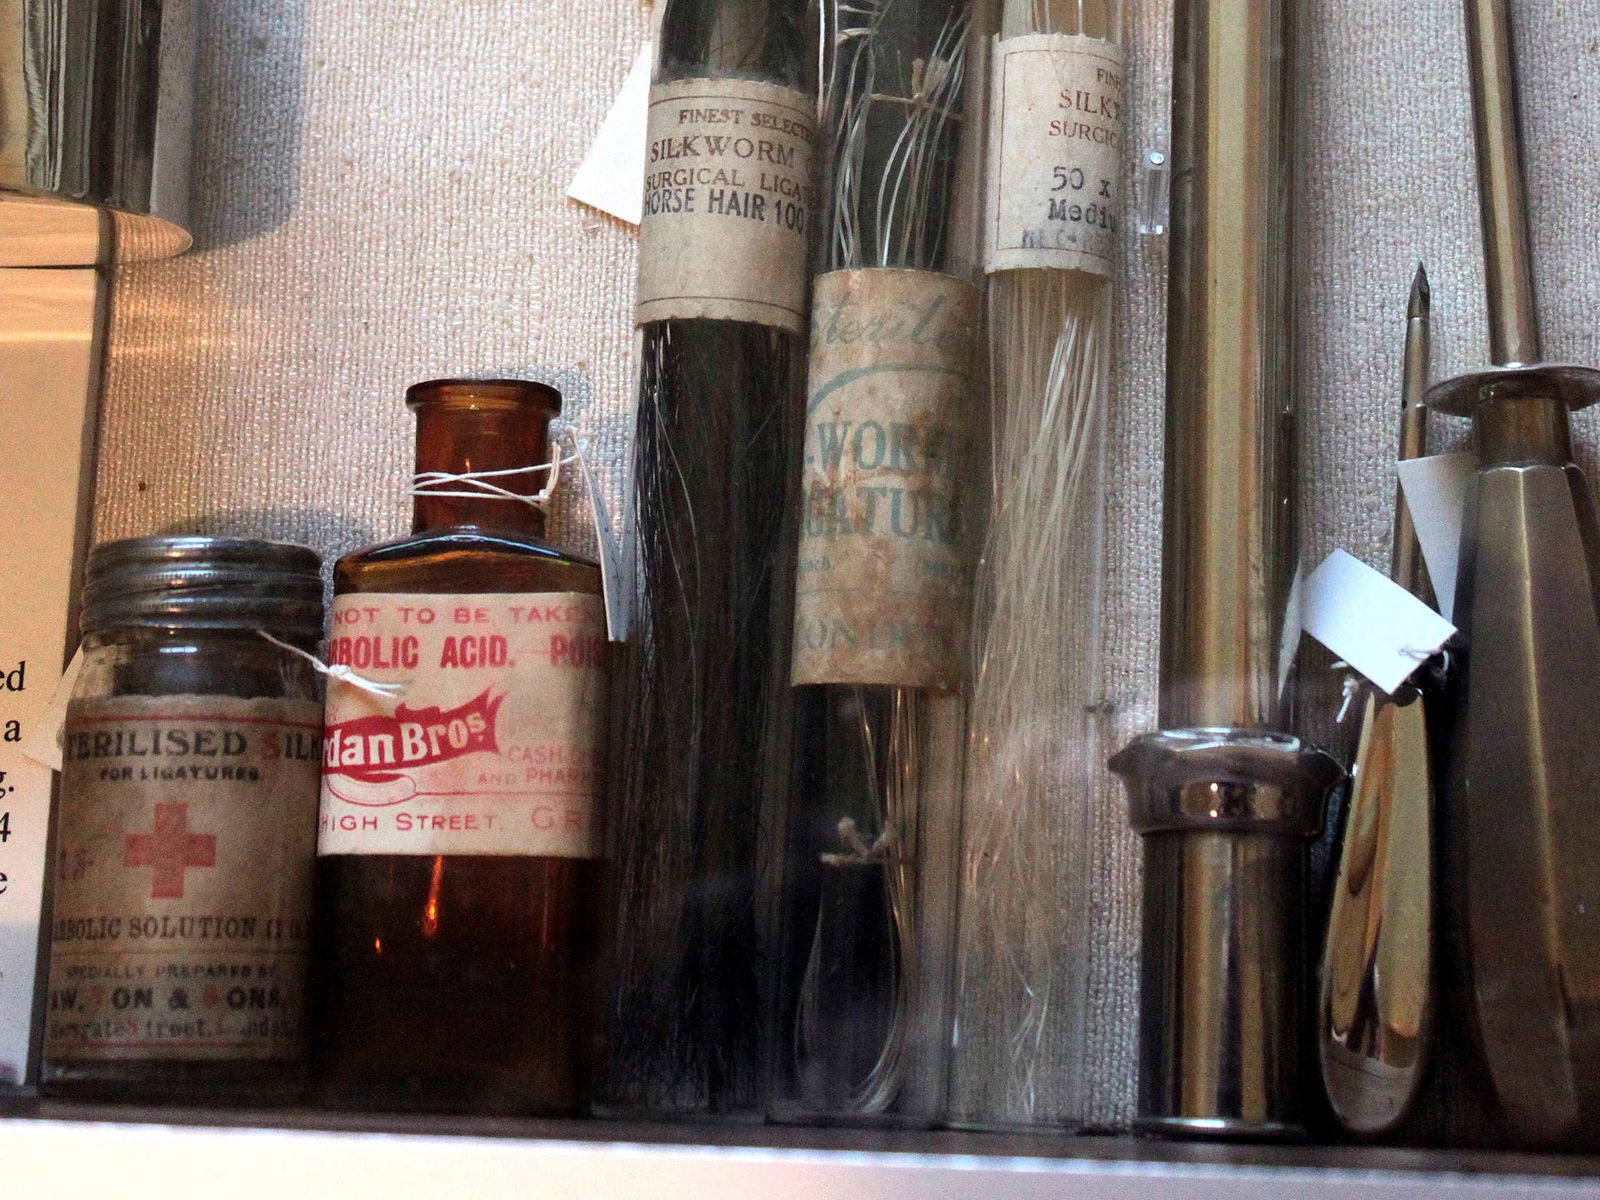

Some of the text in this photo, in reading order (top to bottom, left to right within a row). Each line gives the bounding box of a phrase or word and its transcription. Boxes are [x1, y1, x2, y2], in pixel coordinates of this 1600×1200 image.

[678, 109, 744, 125] FINEST
[1058, 89, 1121, 122] SILK
[1049, 119, 1119, 150] SURGIC
[650, 135, 794, 169] SILKWORM
[646, 168, 745, 193] SURGICAL
[1051, 166, 1085, 192] 50
[644, 188, 805, 235] HORSE HAIR 100
[398, 606, 435, 625] TO
[453, 606, 490, 624] BE
[440, 634, 515, 669] ACID.
[4, 720, 22, 742] a
[400, 711, 487, 762] Bros.
[101, 767, 132, 782] FOR
[128, 915, 257, 940] SOLUTION
